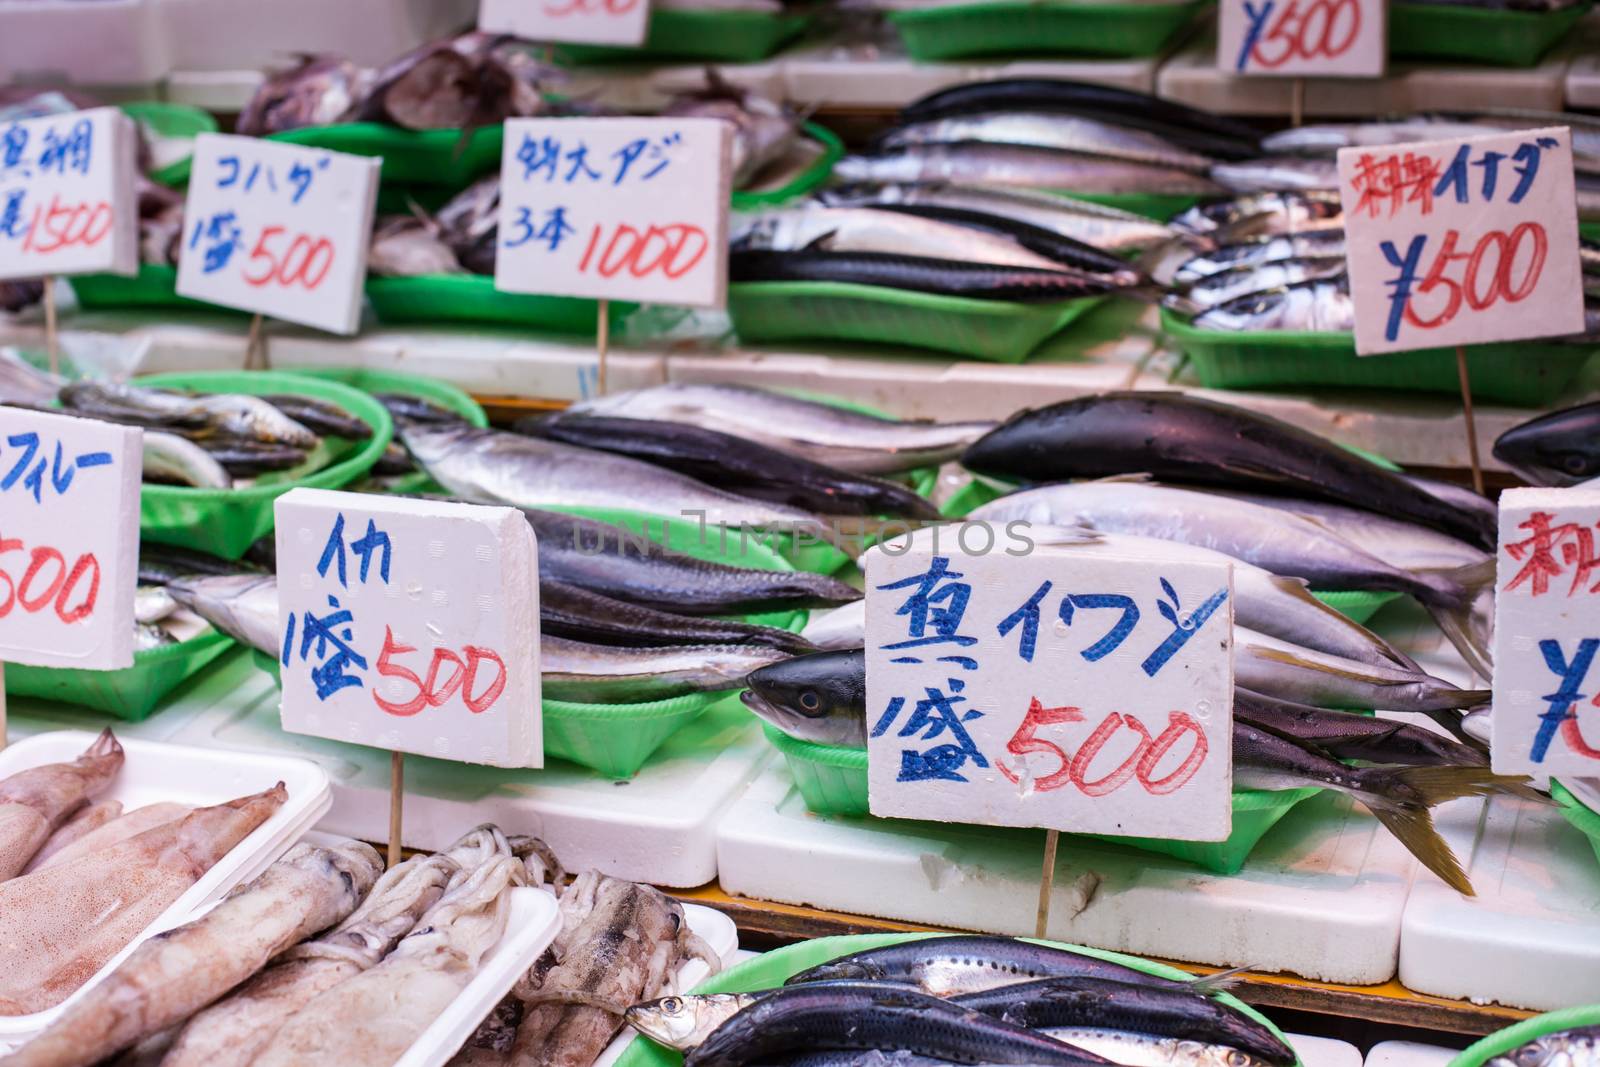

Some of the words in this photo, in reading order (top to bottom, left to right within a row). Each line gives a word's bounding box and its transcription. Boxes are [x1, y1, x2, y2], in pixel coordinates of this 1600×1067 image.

[22, 193, 113, 255] 1500
[242, 223, 336, 291] 500
[577, 222, 709, 280] 1000
[1379, 220, 1548, 343] ¥500
[316, 511, 392, 590] イカ
[1503, 511, 1600, 598] 刺
[372, 623, 508, 718] 500
[994, 695, 1209, 798] 500
